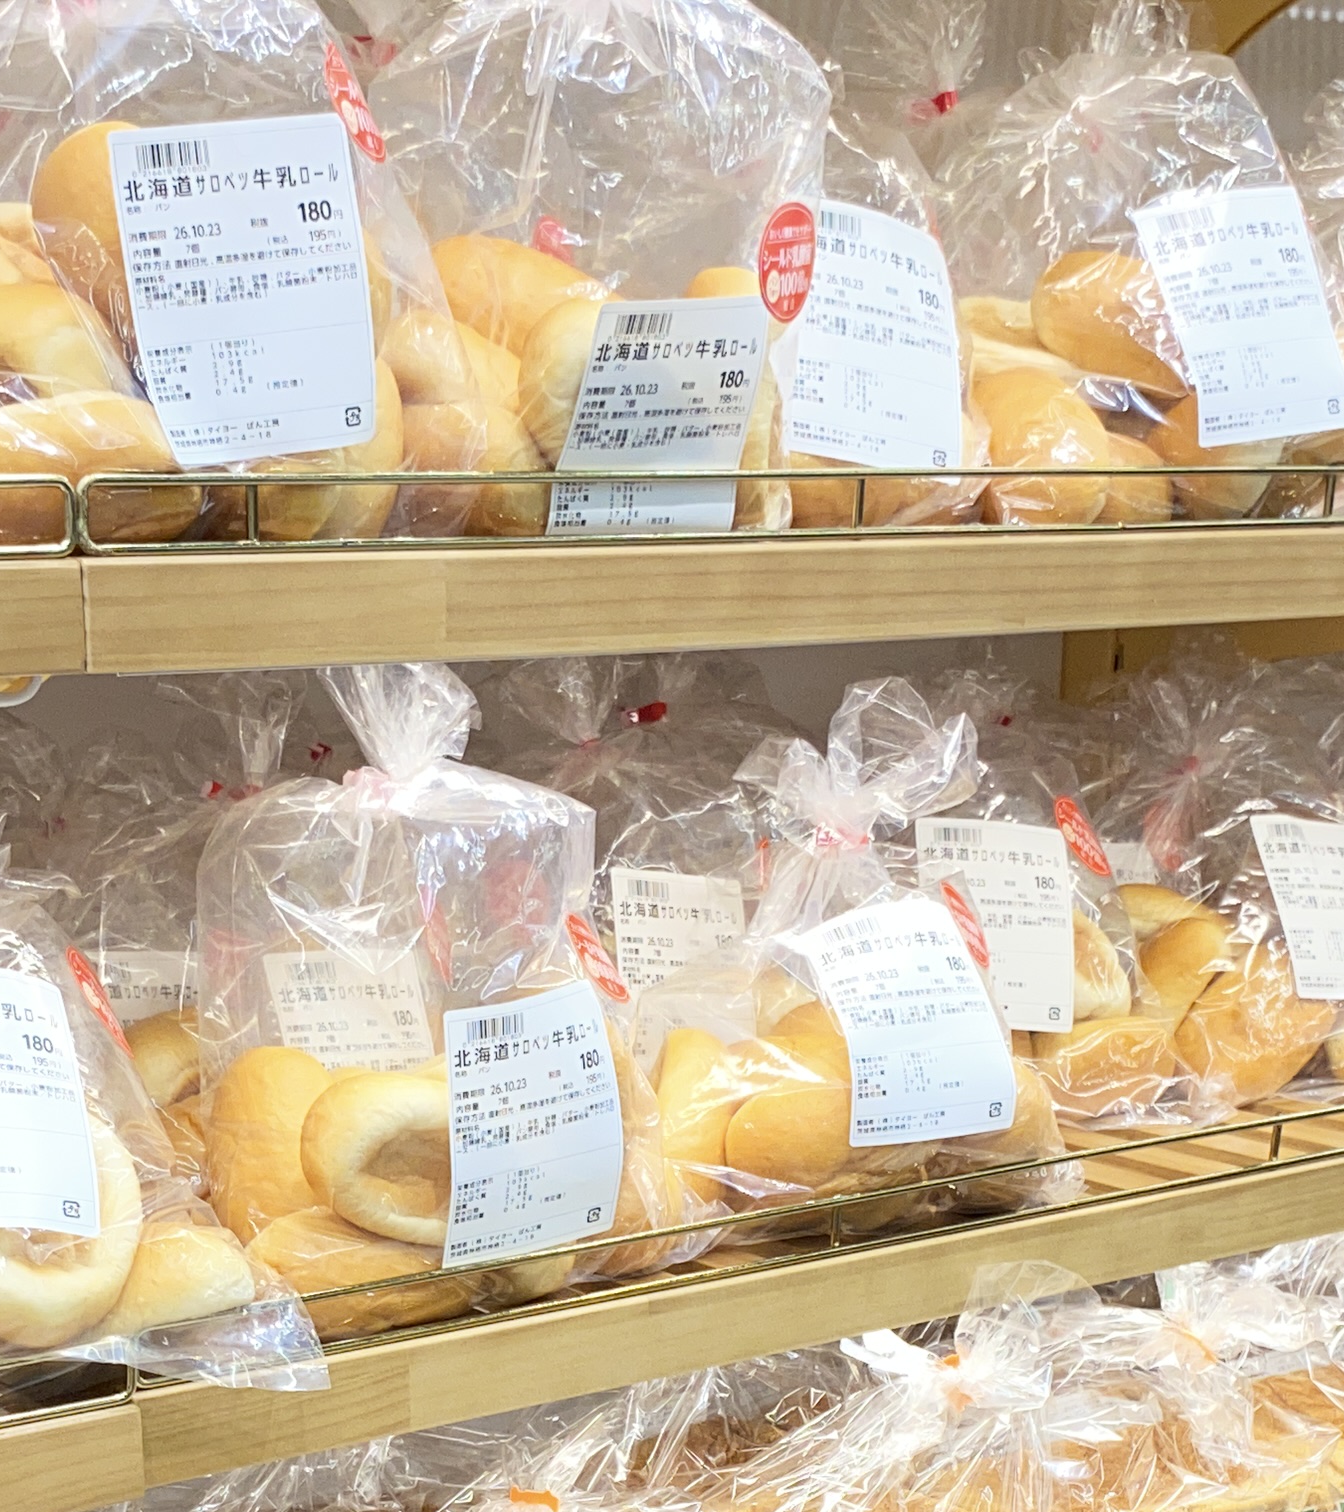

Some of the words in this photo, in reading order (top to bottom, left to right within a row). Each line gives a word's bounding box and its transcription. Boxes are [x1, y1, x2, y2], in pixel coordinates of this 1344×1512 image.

[123, 163, 339, 203] 北海道サロベツ牛乳ロール
[297, 200, 344, 223] 180円
[173, 223, 222, 240] 26.10.23
[133, 247, 162, 259] 内容量
[595, 338, 758, 362] 北海道サロベツ牛乳ロール
[719, 370, 750, 389] 180円
[620, 384, 658, 396] 26.10.23
[454, 1018, 599, 1069] 北海道サロベツ牛乳ロール
[490, 1078, 527, 1096] 26.10.23
